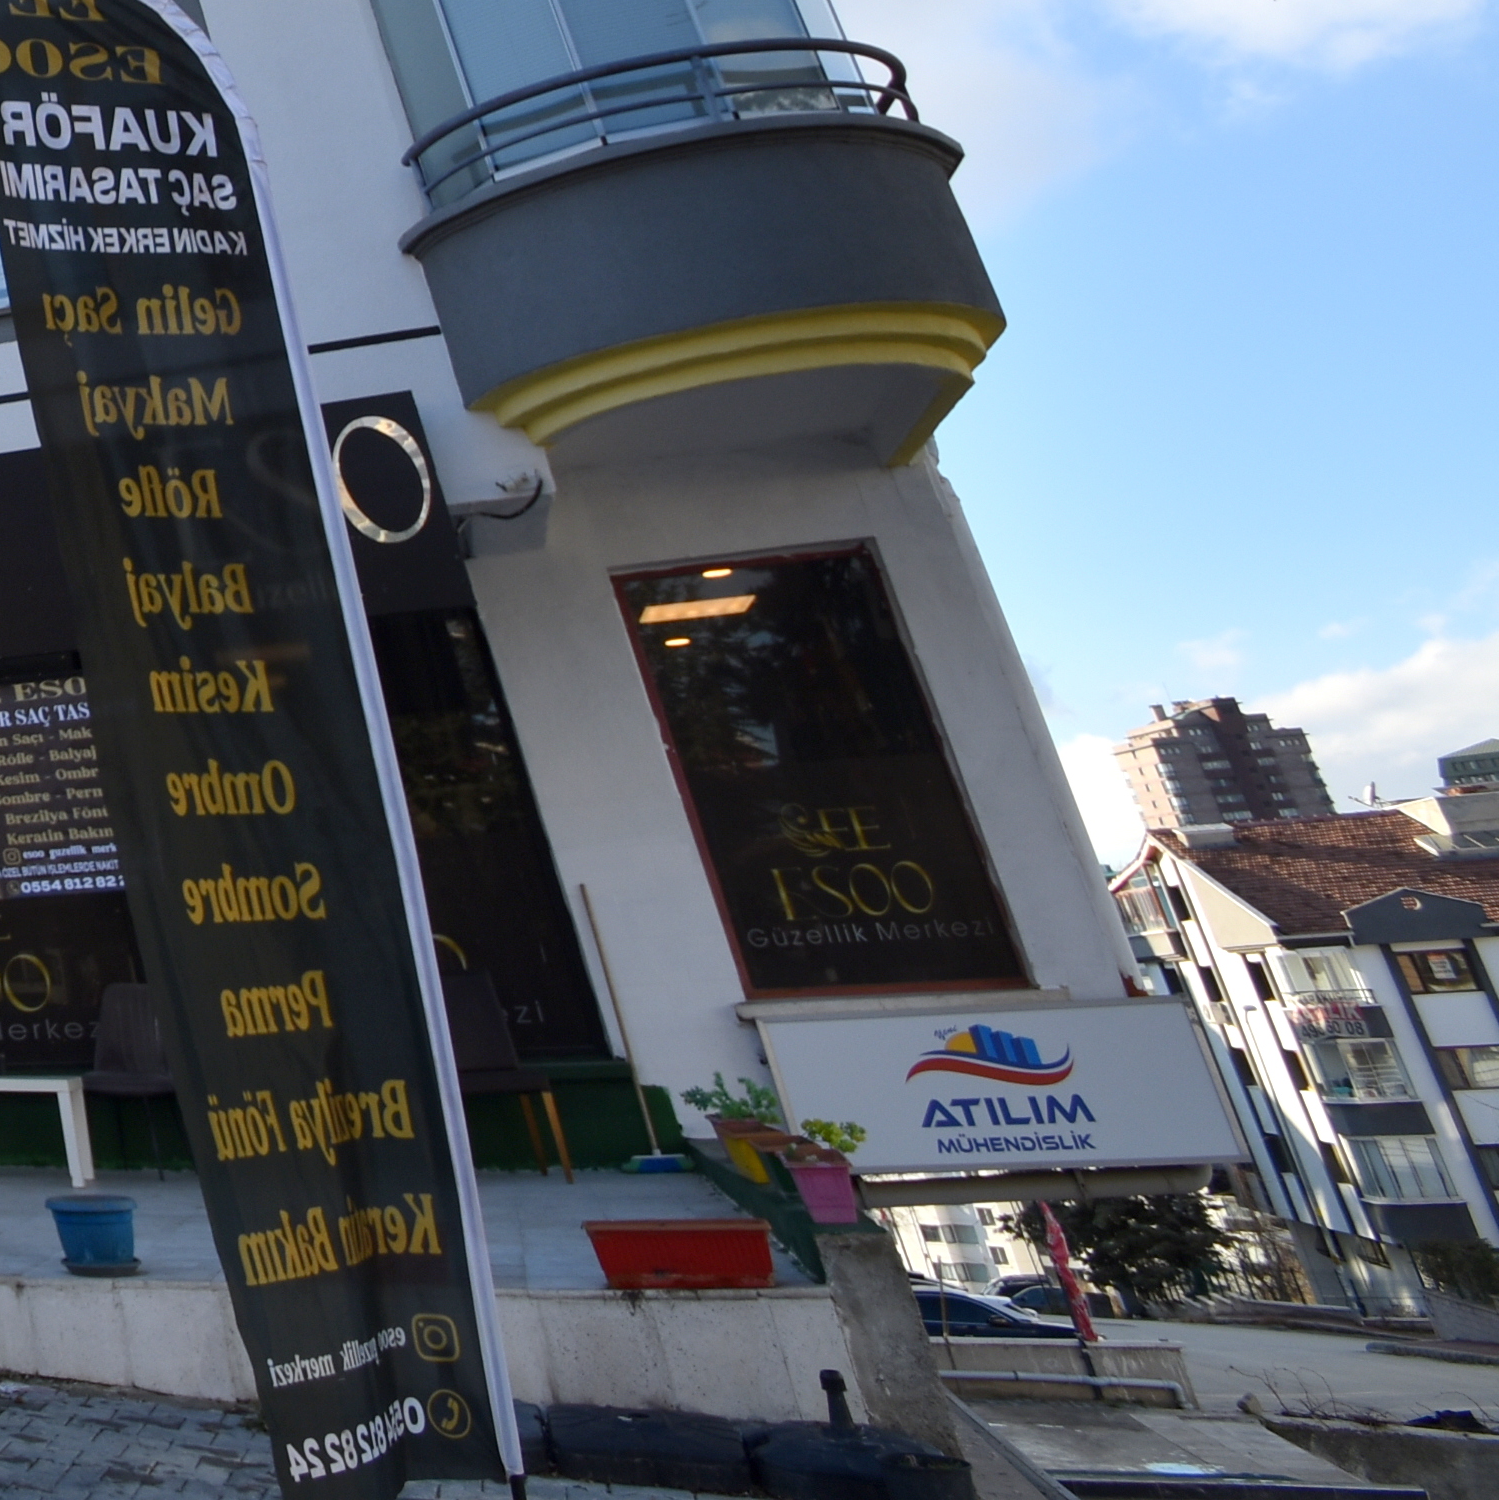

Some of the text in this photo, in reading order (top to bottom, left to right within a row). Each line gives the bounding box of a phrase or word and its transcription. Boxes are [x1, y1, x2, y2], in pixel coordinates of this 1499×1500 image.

[12, 676, 87, 702] ESO
[15, 705, 50, 727] SAÇ
[54, 702, 91, 720] TAS
[12, 732, 44, 746] Saçı
[59, 726, 93, 741] Mak
[49, 745, 97, 763] Balyaj
[55, 765, 99, 781] Ombr
[5, 807, 69, 825] Brezilya
[7, 828, 64, 846] Keratin
[91, 843, 117, 855] merk
[21, 864, 46, 877] BÜTÜN
[47, 861, 94, 875] İŞLEMLERDE
[21, 877, 62, 893] 0554
[64, 876, 94, 890] 812
[96, 875, 117, 888] 82
[747, 917, 995, 948] Güzellik Merkezi
[1345, 1021, 1365, 1036] 08
[921, 1094, 1096, 1128] ATILIM
[937, 1130, 1096, 1154] MÜHENDİSLİK
